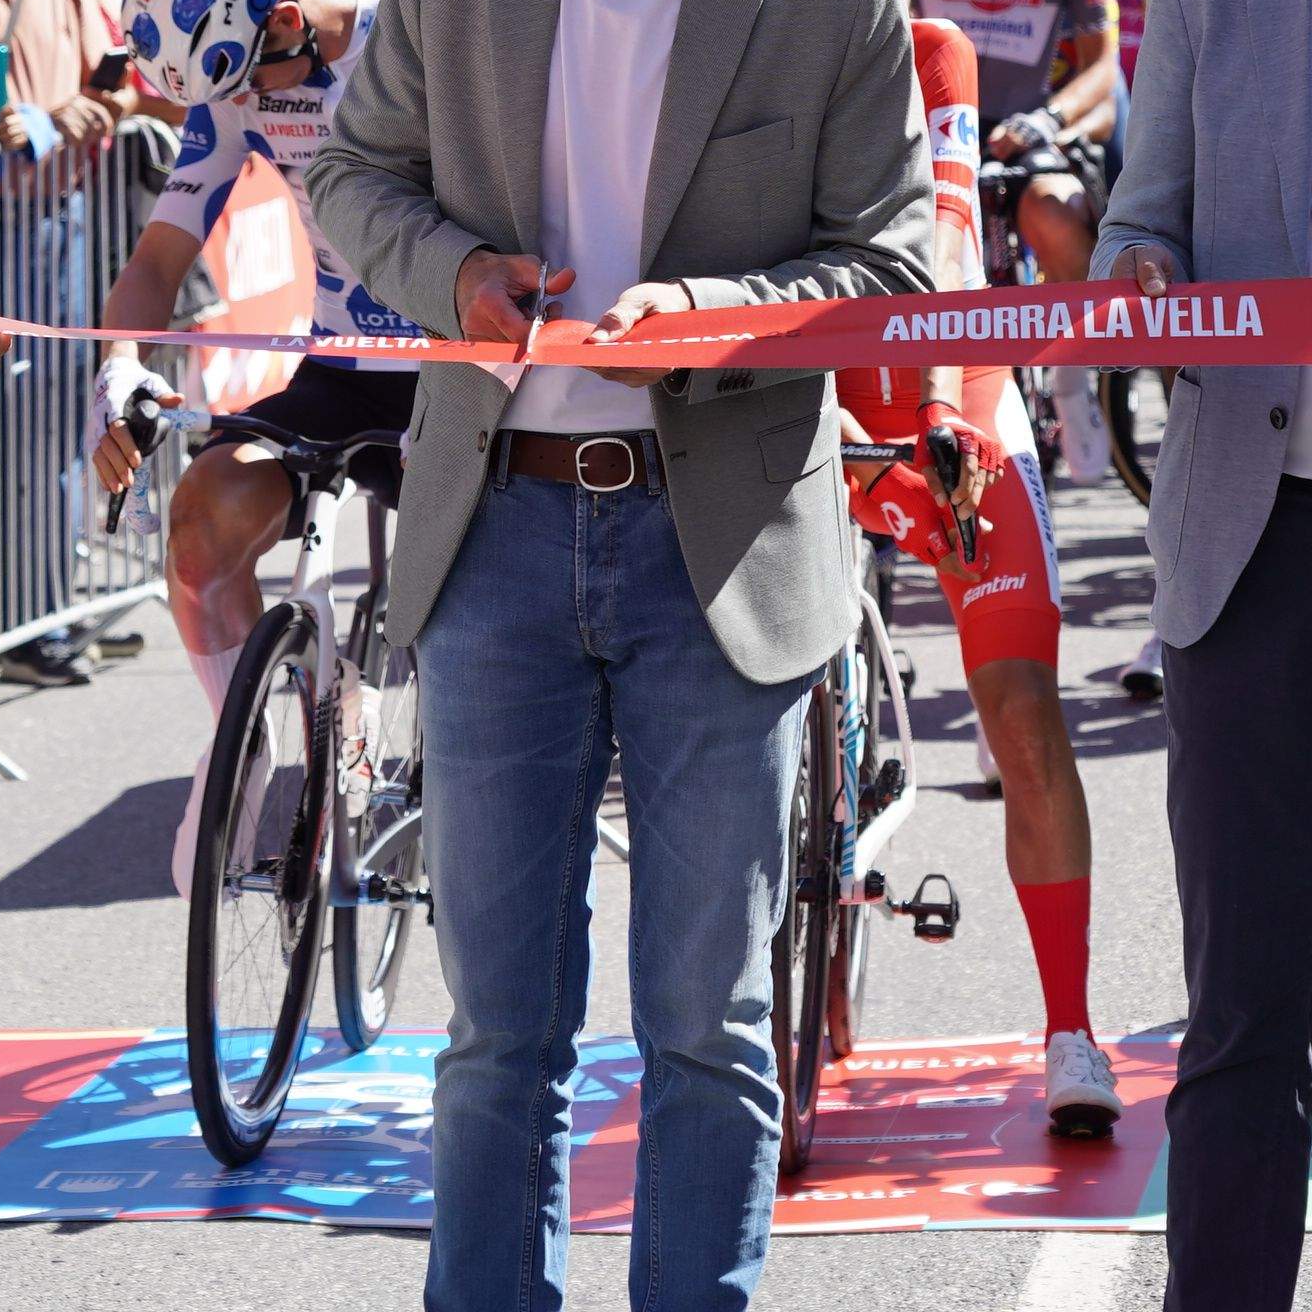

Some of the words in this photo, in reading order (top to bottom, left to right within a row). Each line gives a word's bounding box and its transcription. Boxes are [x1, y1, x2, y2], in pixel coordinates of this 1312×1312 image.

[258, 95, 323, 114] Santini
[882, 302, 1075, 341] ANDORRA
[1083, 296, 1134, 339] LA
[1139, 295, 1264, 338] VELLA
[270, 336, 306, 348] LA
[314, 336, 431, 349] VUELTA
[843, 1054, 998, 1071] VUELTA
